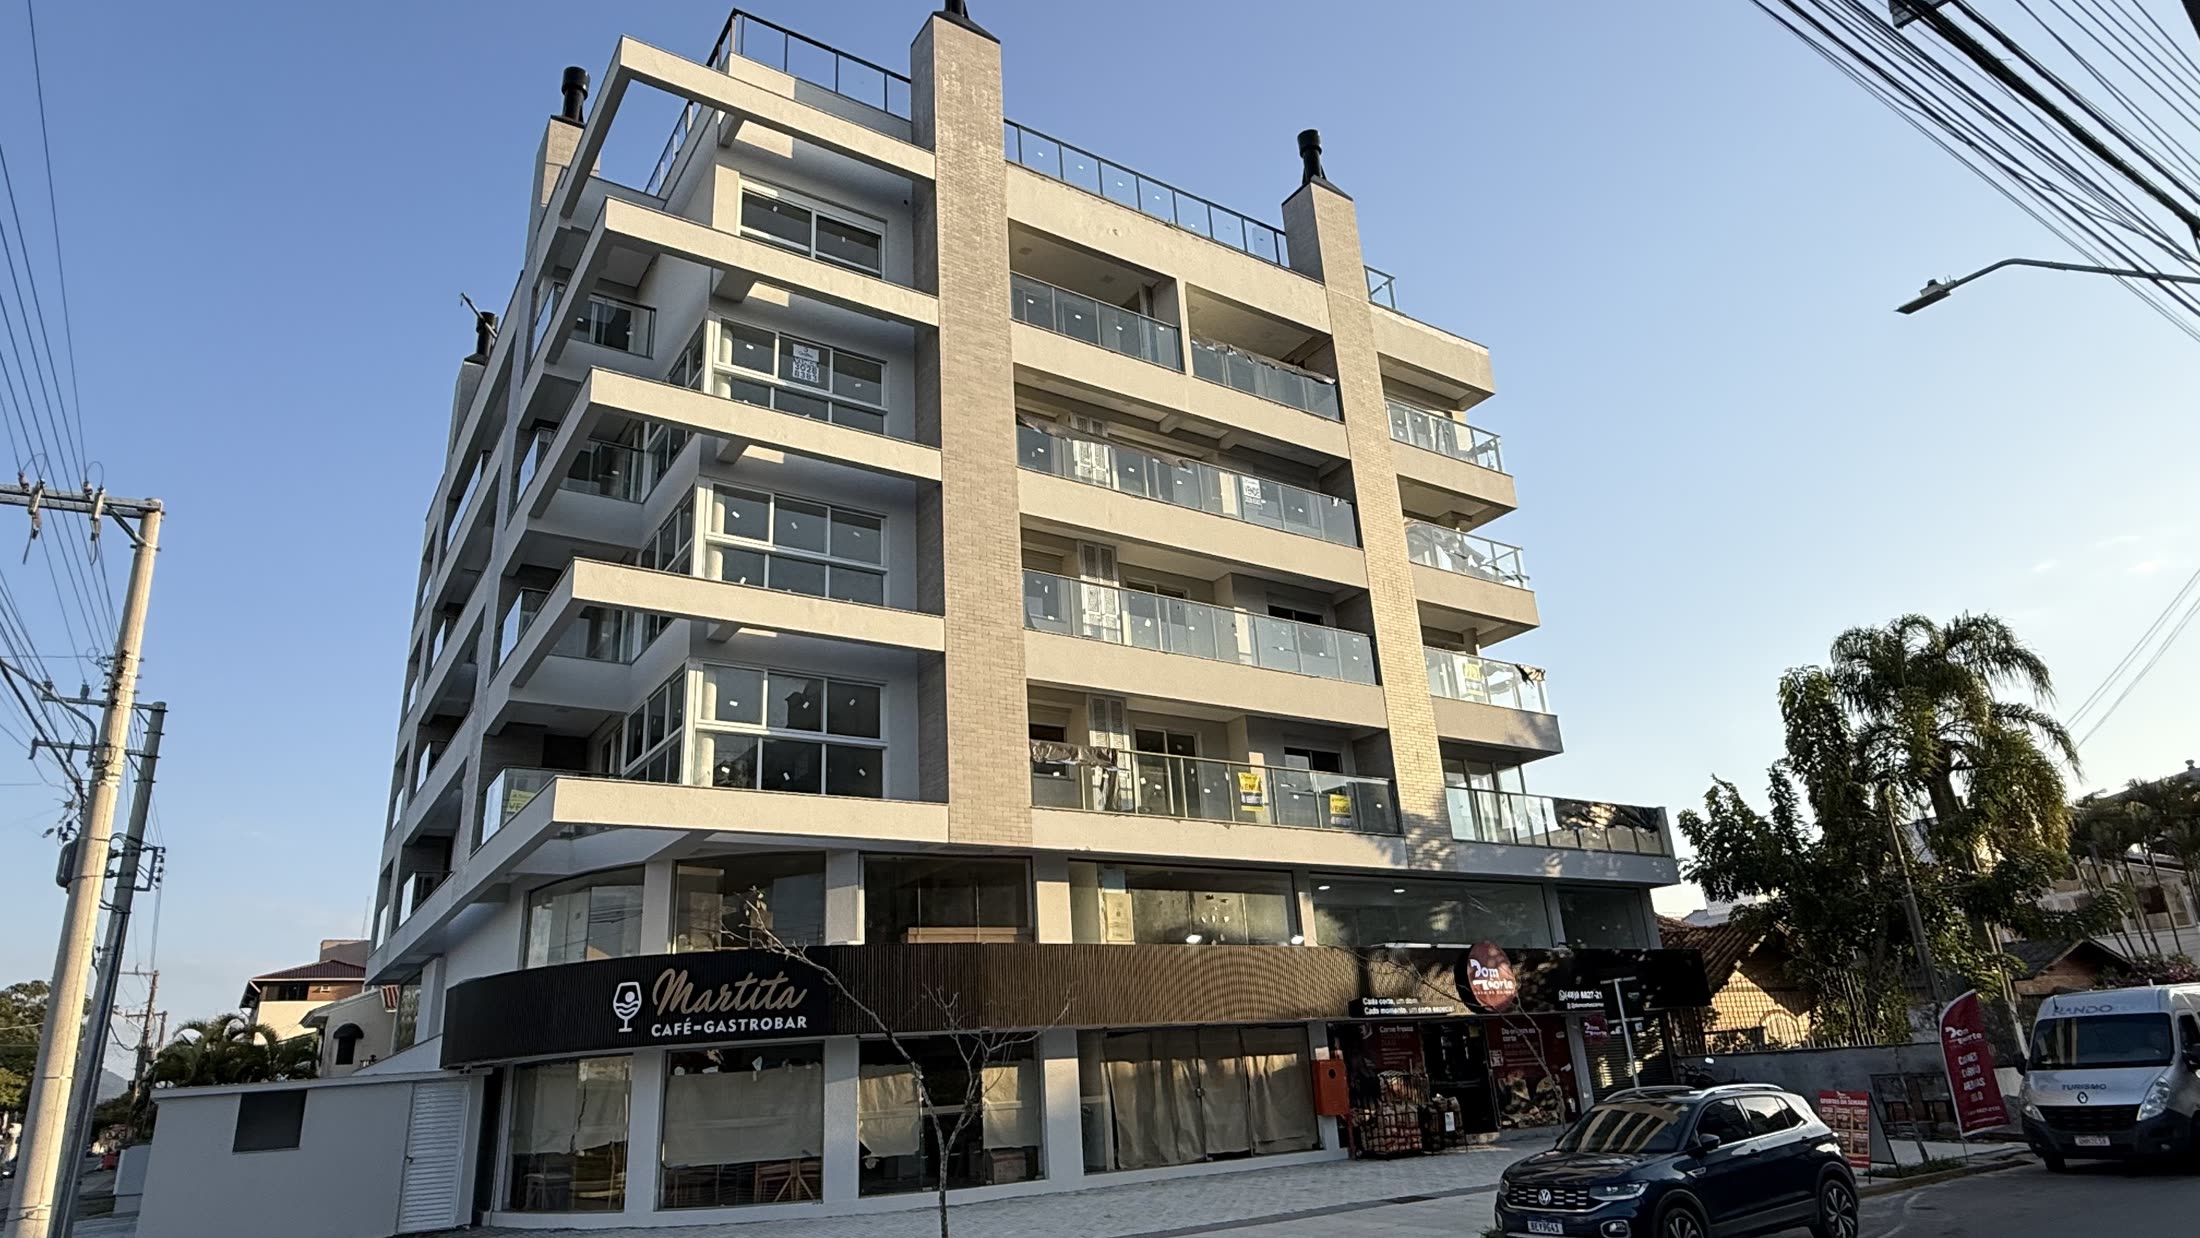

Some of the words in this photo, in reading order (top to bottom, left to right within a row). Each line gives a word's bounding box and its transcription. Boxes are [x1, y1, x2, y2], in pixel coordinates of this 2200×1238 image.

[652, 968, 808, 1016] Martita
[1363, 997, 1378, 1006] Cada
[1364, 1007, 1379, 1015] Cada
[1379, 1025, 1396, 1033] Carne
[2062, 1083, 2107, 1091] TURISMO
